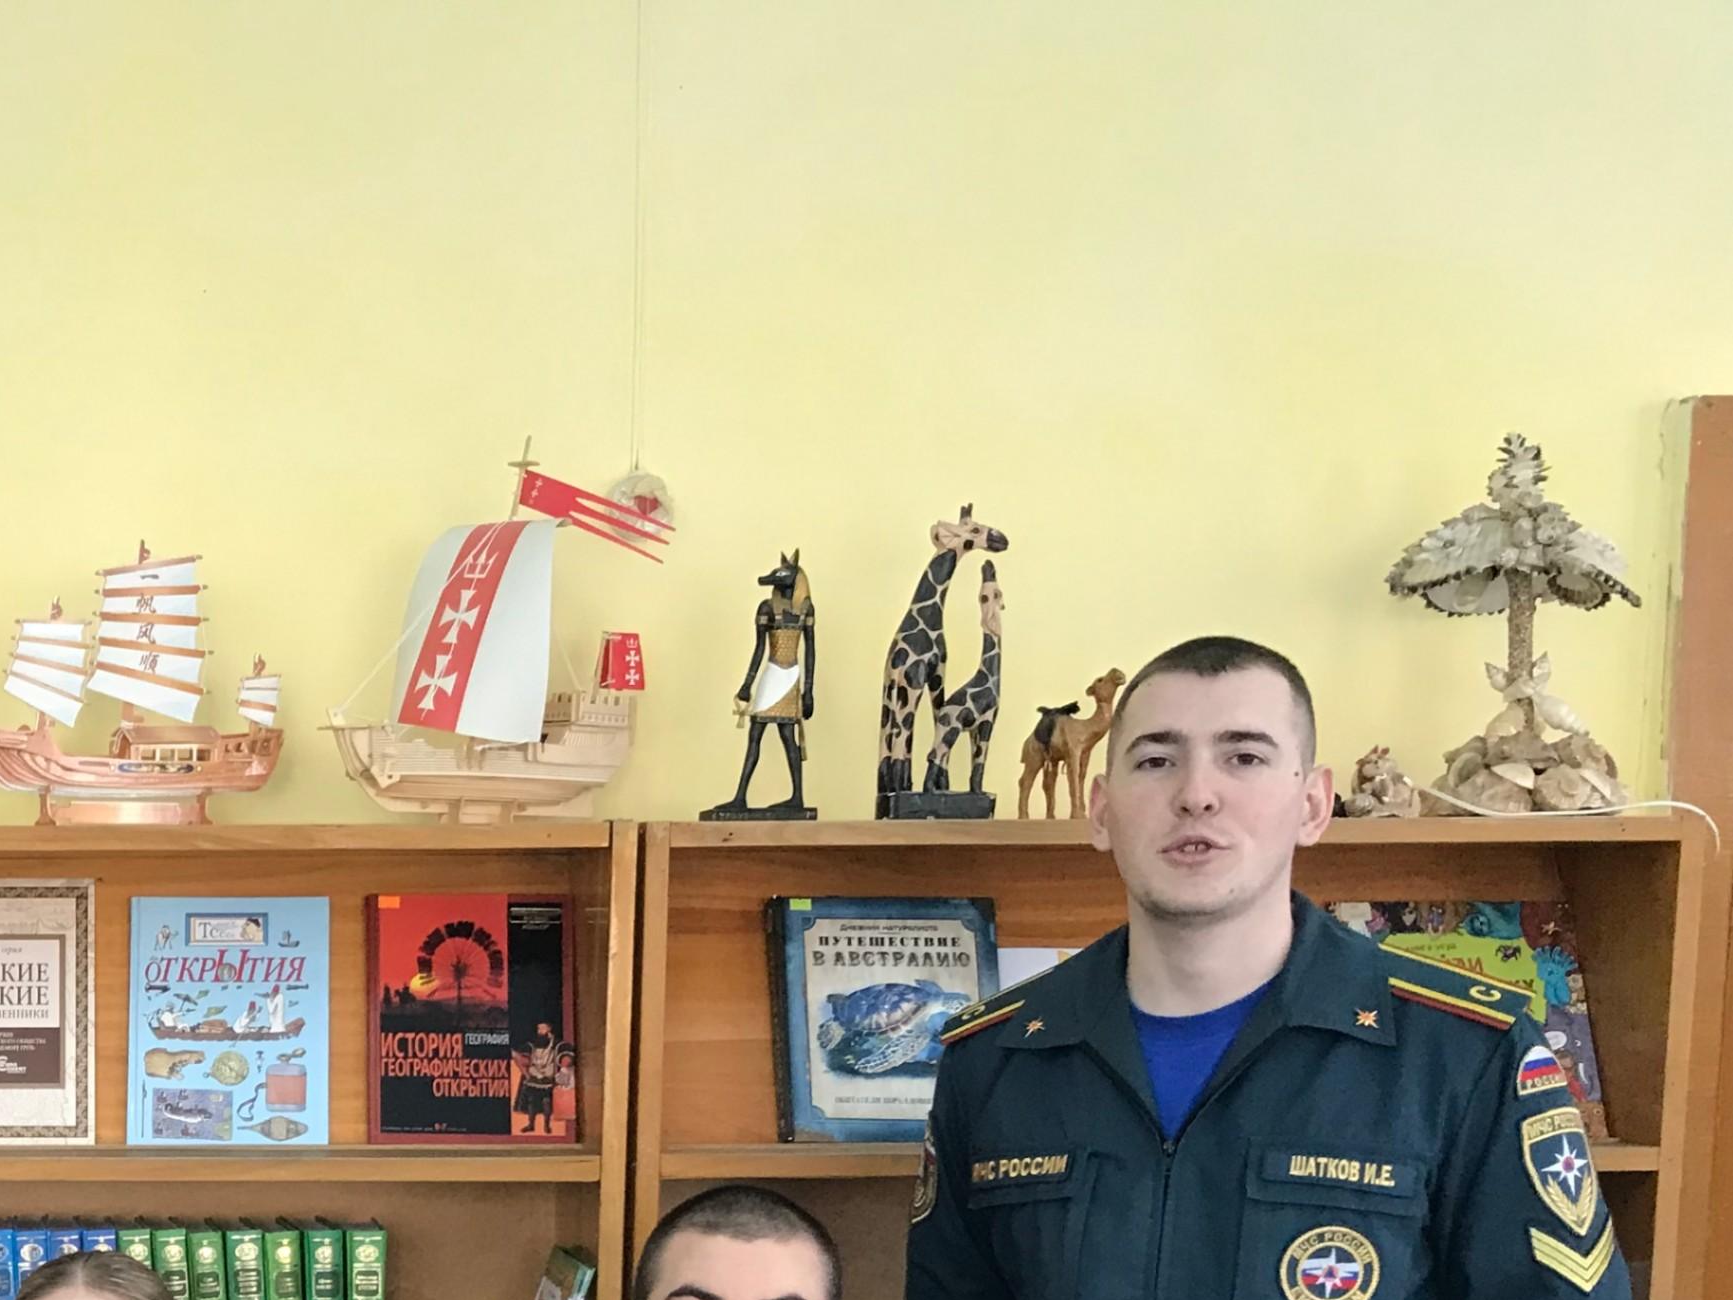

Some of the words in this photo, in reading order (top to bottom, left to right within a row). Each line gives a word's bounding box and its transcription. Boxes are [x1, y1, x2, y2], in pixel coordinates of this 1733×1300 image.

[818, 936, 962, 948] ПУТЕШЕСТВИЕ
[144, 948, 307, 983] ОТКРЫТИЯ
[812, 950, 826, 966] В
[834, 951, 970, 968] АВСТРАЛИЮ
[381, 1032, 463, 1058] ИСТОРИЯ
[464, 1032, 510, 1046] ГЕОГРАФИЯ
[381, 1058, 509, 1078] ГЕОГРАФИЧЕСКИХ
[999, 1153, 1068, 1179] РОССИИ
[1289, 1155, 1360, 1182] ШАТКОВ
[1363, 1162, 1396, 1187] И.Е.
